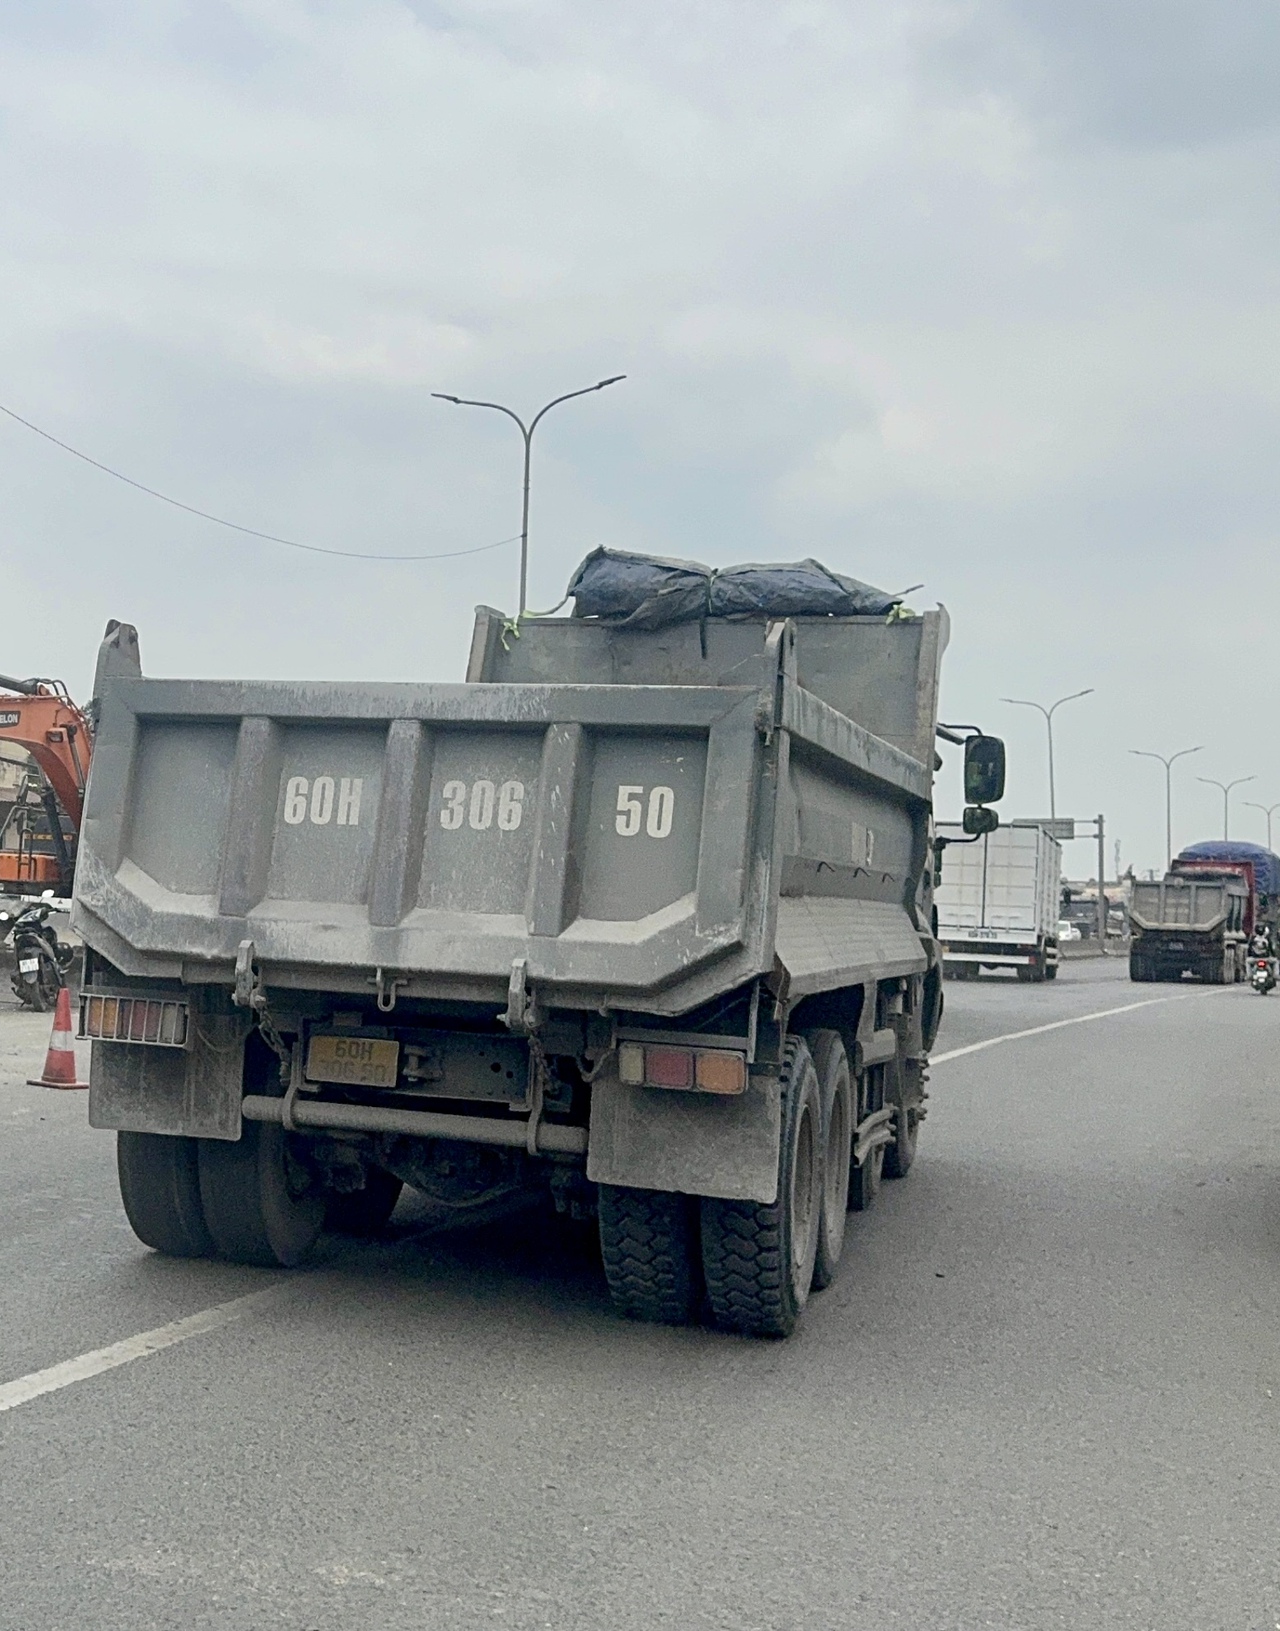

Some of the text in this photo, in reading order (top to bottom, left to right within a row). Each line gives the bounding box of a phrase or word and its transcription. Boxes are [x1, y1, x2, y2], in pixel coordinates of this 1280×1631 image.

[283, 776, 675, 838] 60H 306 50
